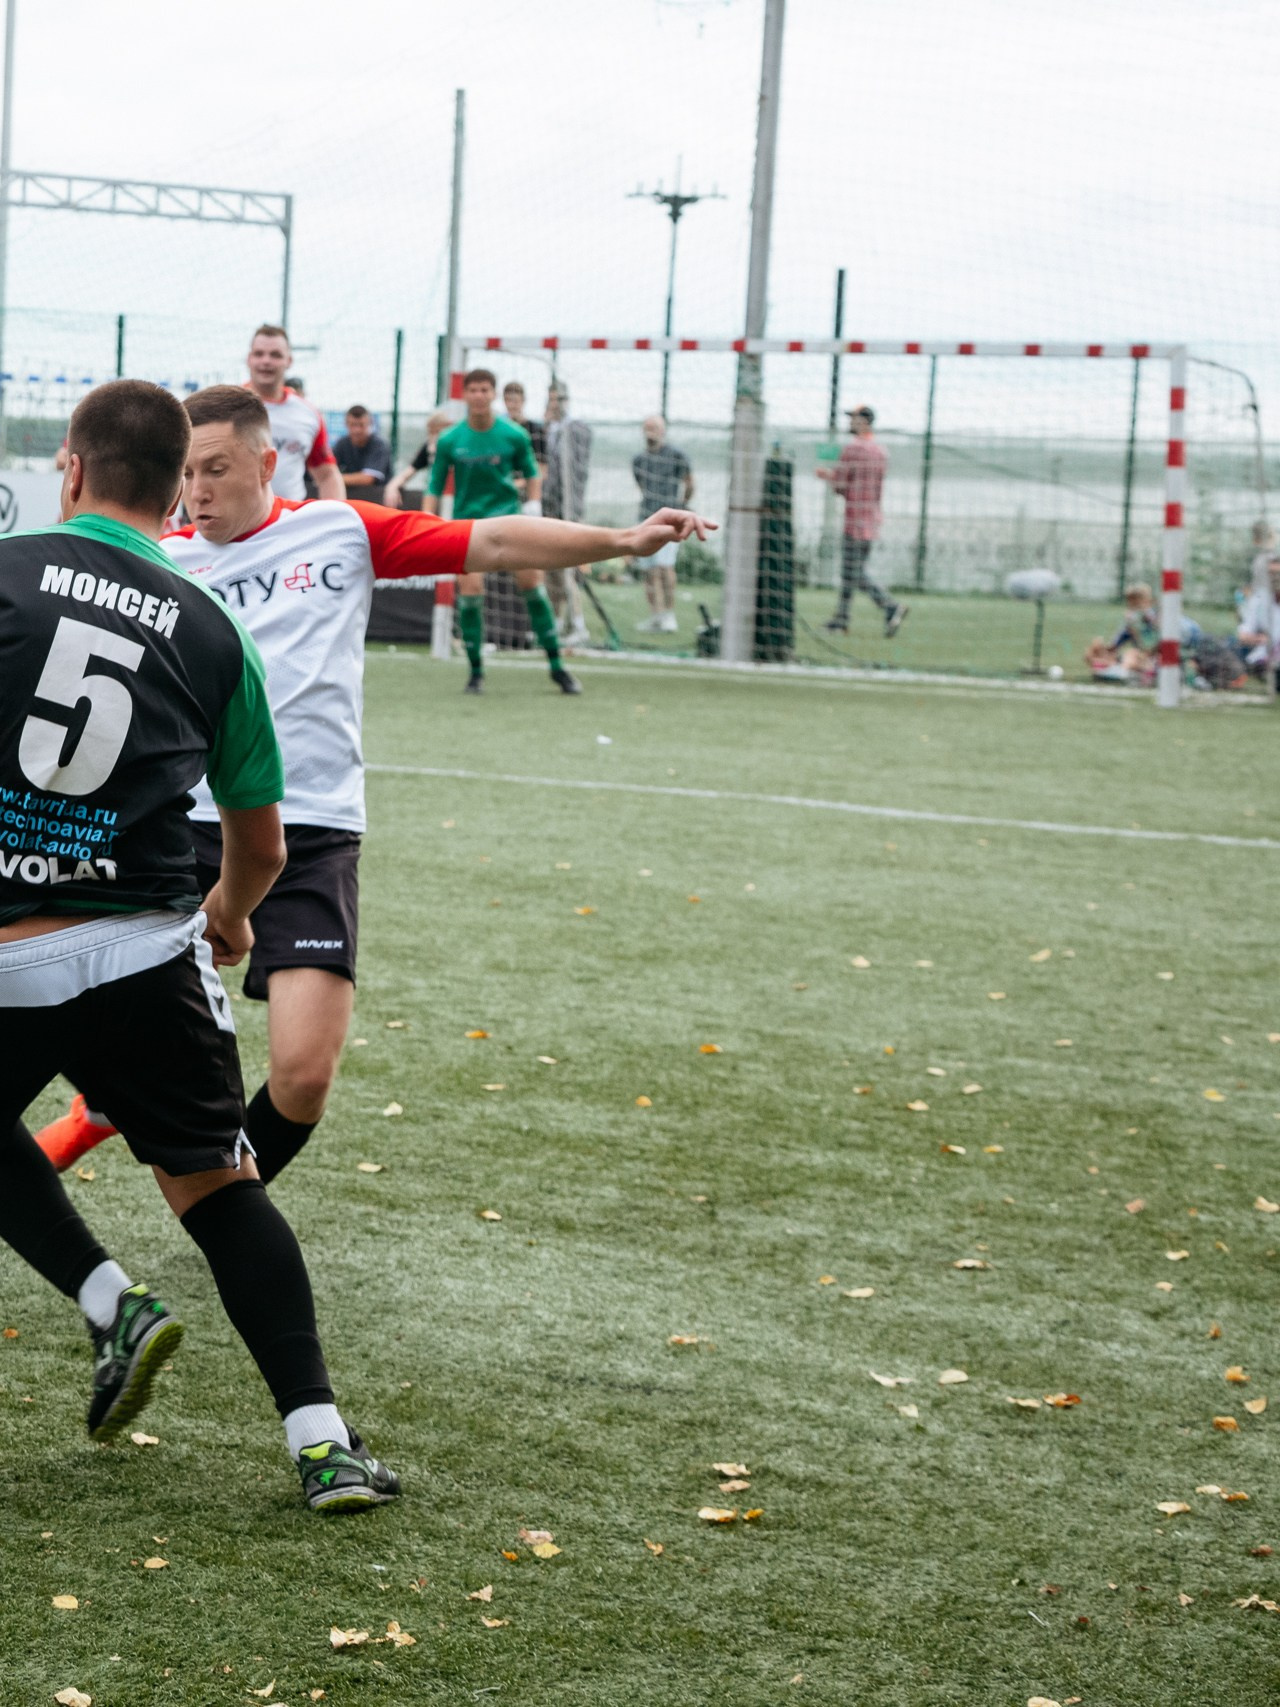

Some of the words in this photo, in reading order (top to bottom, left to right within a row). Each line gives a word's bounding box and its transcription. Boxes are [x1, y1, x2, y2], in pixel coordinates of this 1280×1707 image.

[39, 564, 180, 640] МОИСЕЙ
[18, 616, 146, 796] 5
[295, 939, 344, 949] MAVEX
